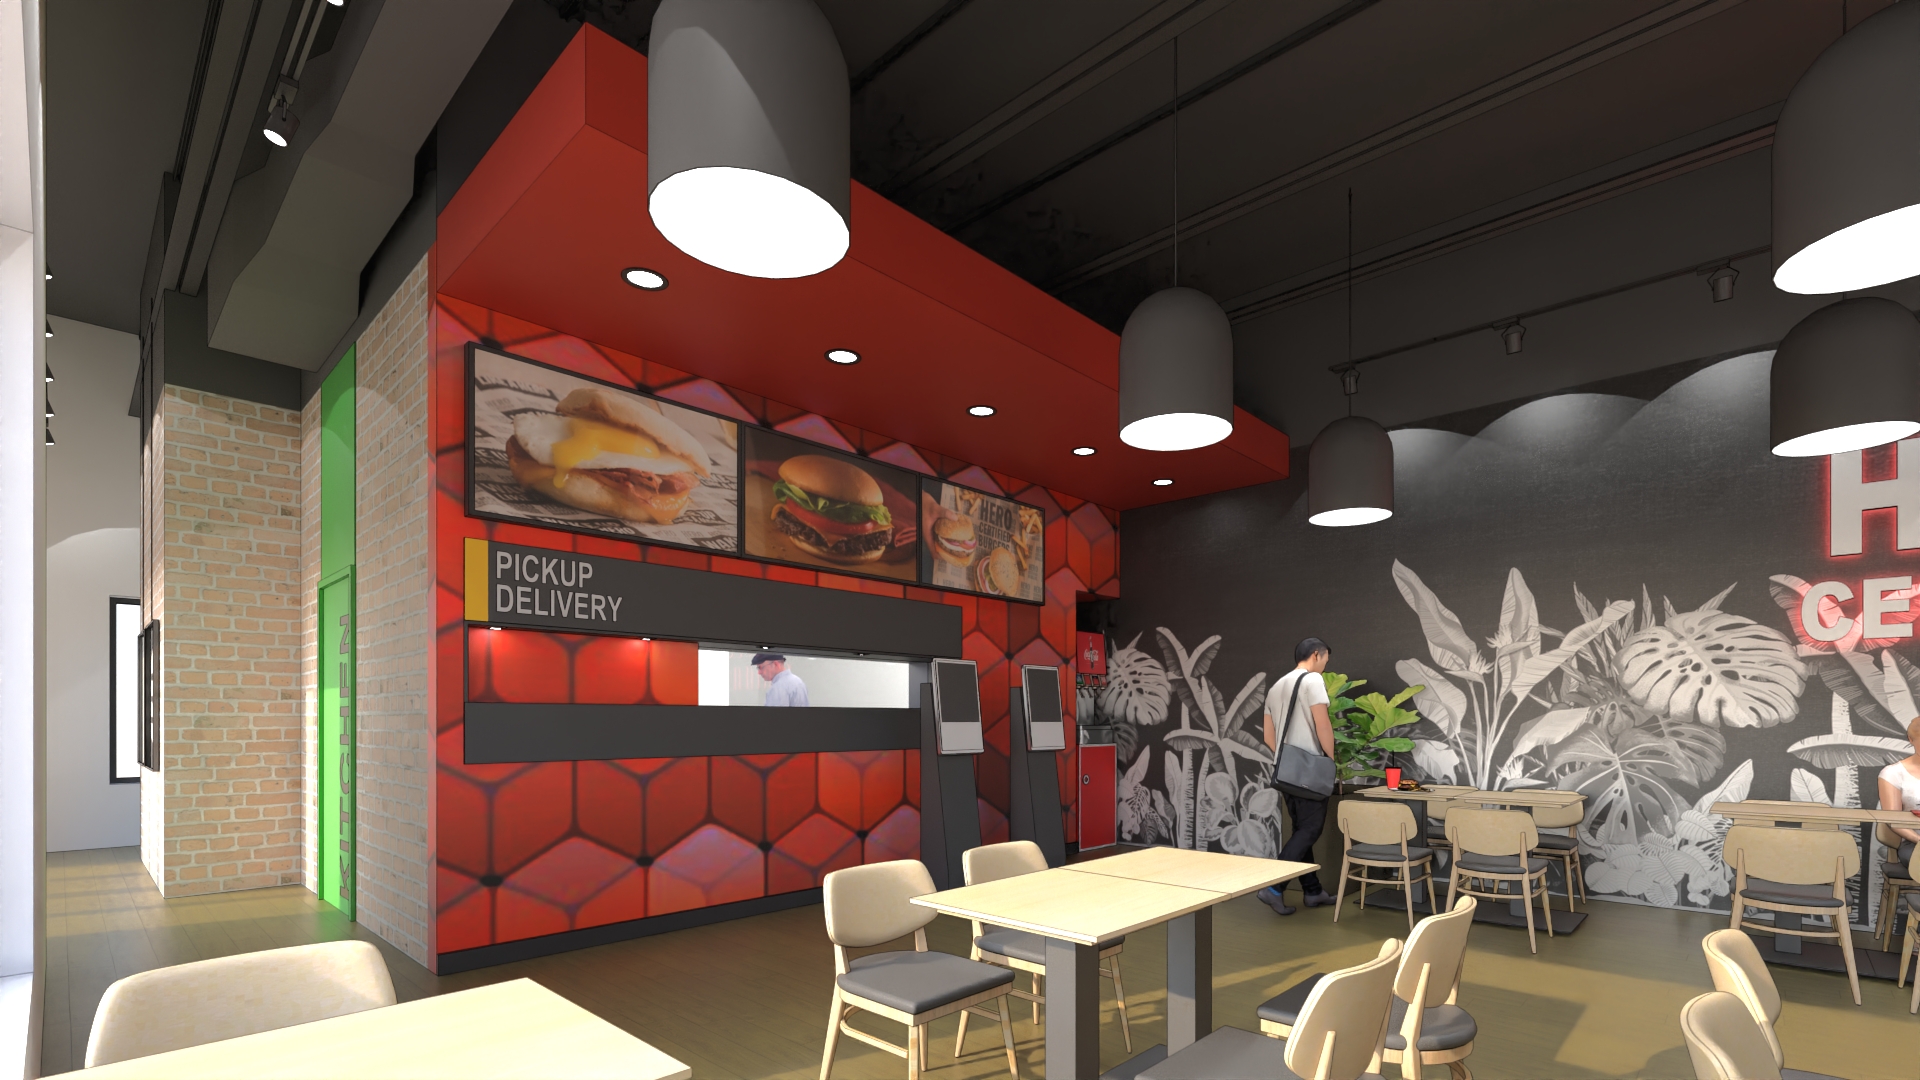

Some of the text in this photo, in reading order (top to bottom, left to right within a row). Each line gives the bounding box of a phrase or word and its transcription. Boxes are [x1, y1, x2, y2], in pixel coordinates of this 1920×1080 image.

[979, 521, 1011, 543] CERTIFIED
[980, 498, 1012, 531] HERO
[496, 550, 594, 588] PICKUP
[496, 583, 623, 622] DELIVERY
[1800, 575, 1914, 642] CE
[339, 613, 350, 901] KITCHEN
